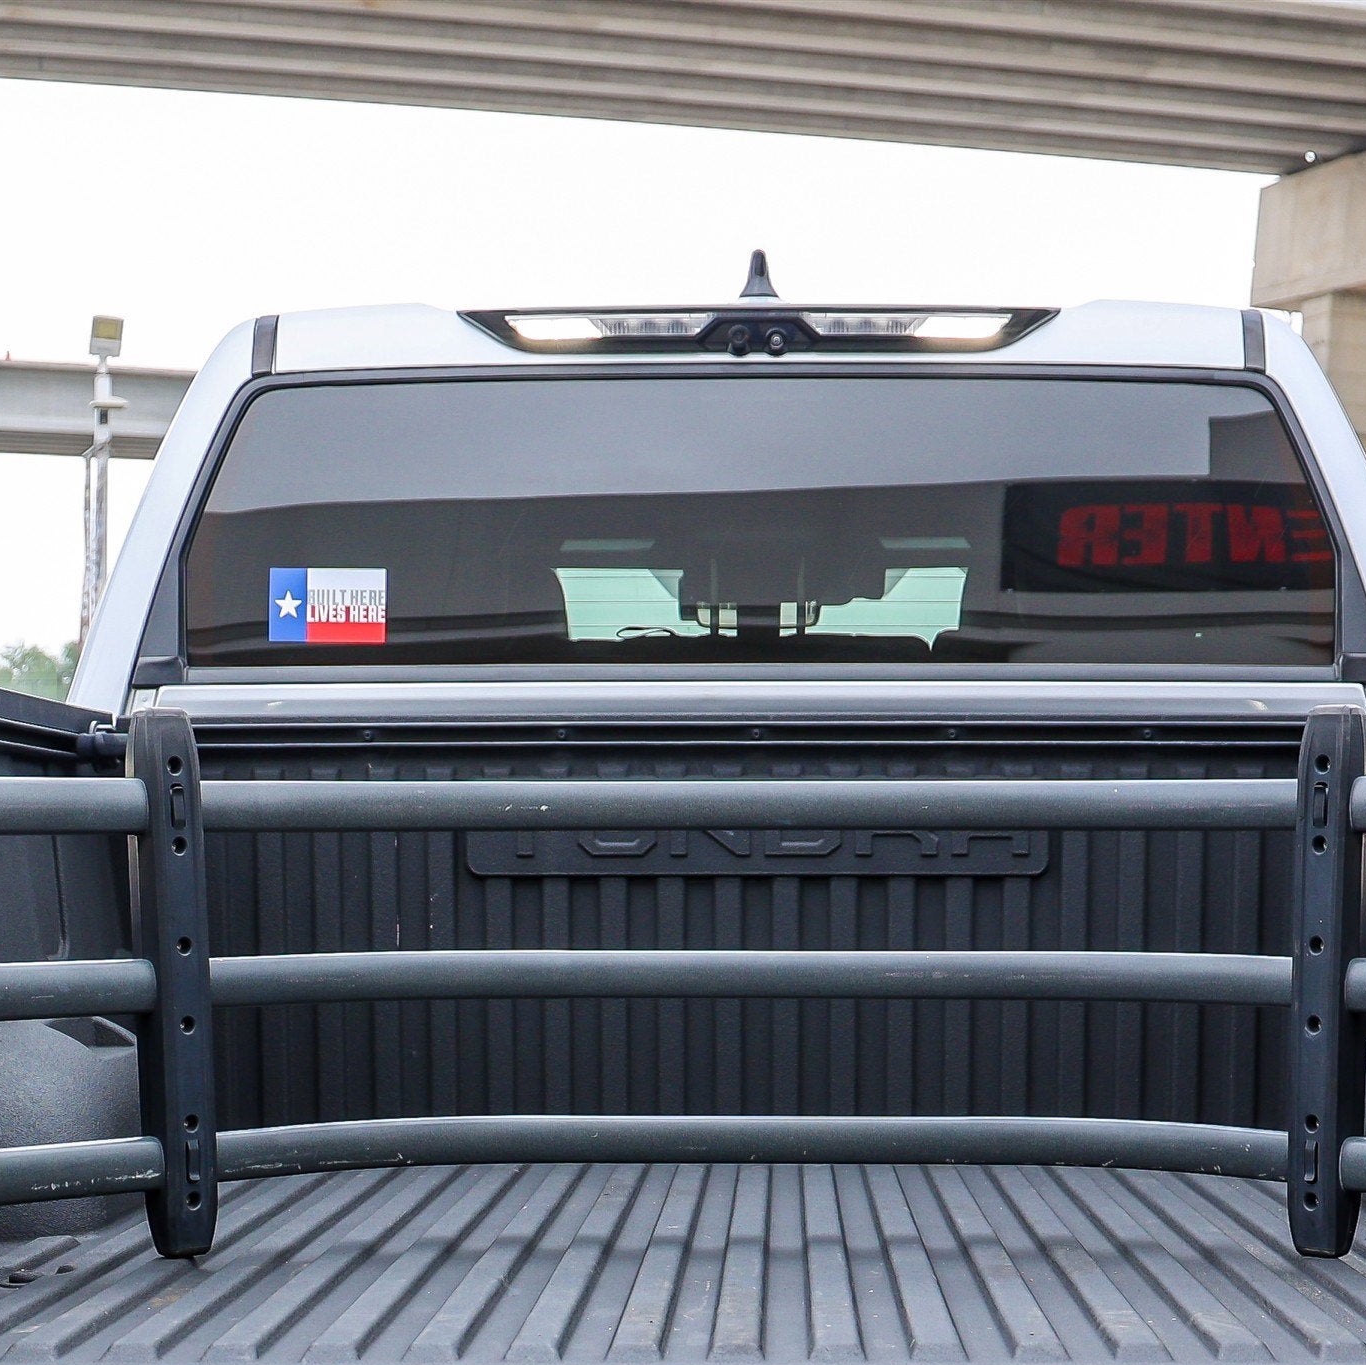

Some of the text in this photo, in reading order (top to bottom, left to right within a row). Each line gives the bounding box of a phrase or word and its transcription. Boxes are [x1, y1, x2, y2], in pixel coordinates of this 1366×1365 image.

[307, 589, 386, 606] BUILT HERE
[307, 605, 386, 623] LIVES HERE
